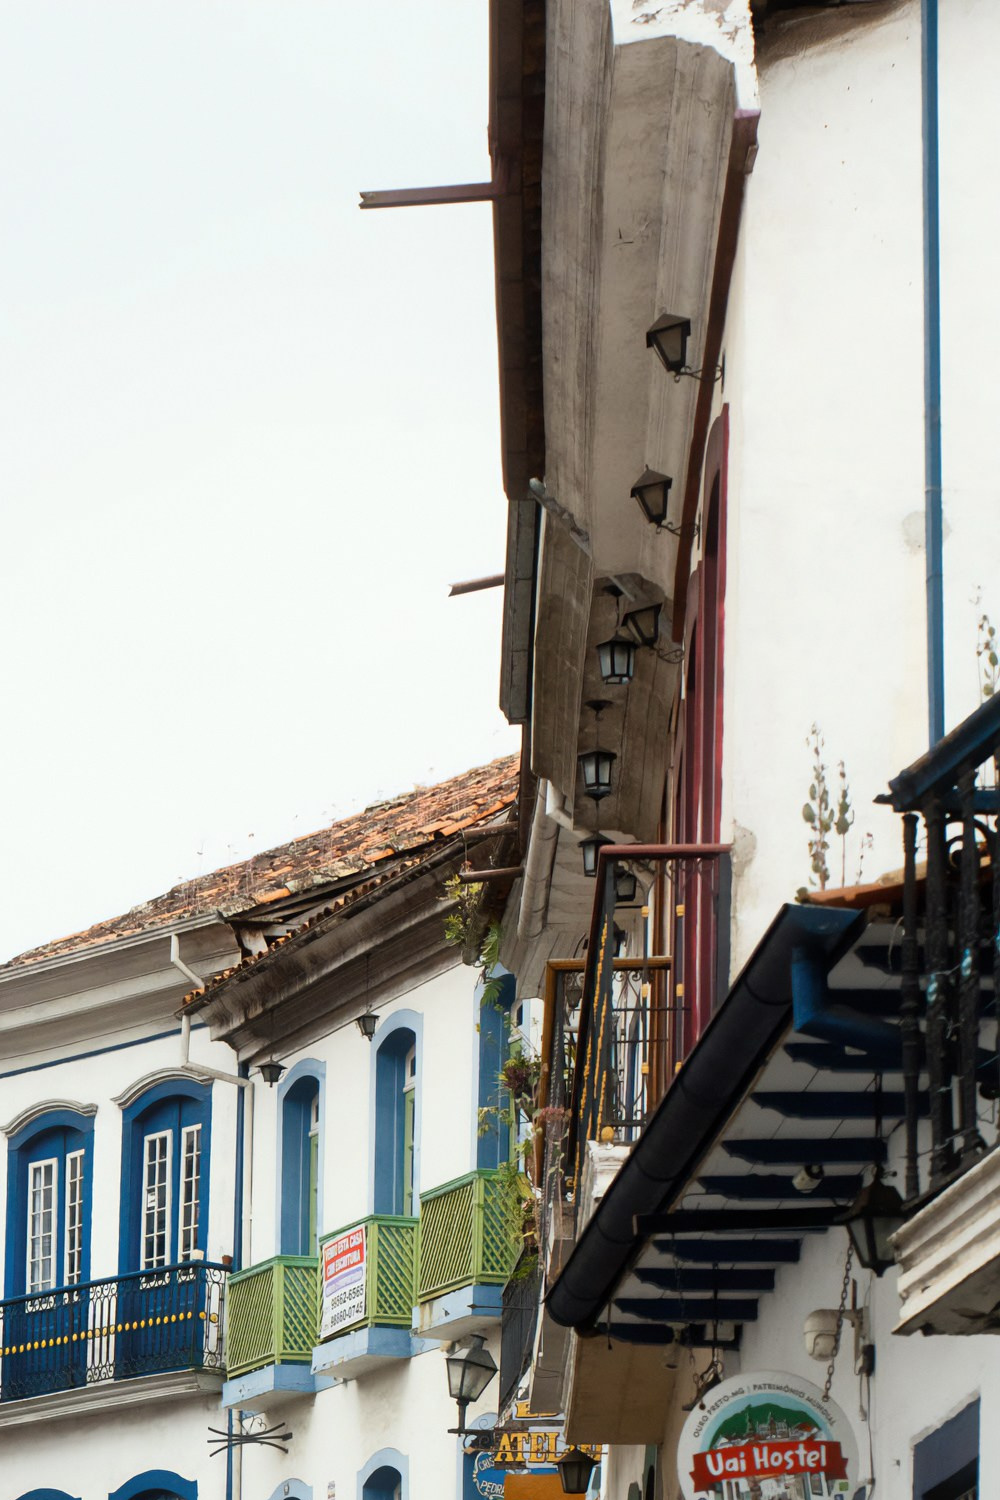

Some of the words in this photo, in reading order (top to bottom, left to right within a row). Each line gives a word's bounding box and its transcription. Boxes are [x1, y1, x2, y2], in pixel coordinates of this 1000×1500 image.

[692, 1414, 710, 1438] OURO
[752, 1382, 806, 1399] PATRIMÔNIO
[705, 1451, 748, 1477] Uai
[752, 1443, 828, 1471] Hostel
